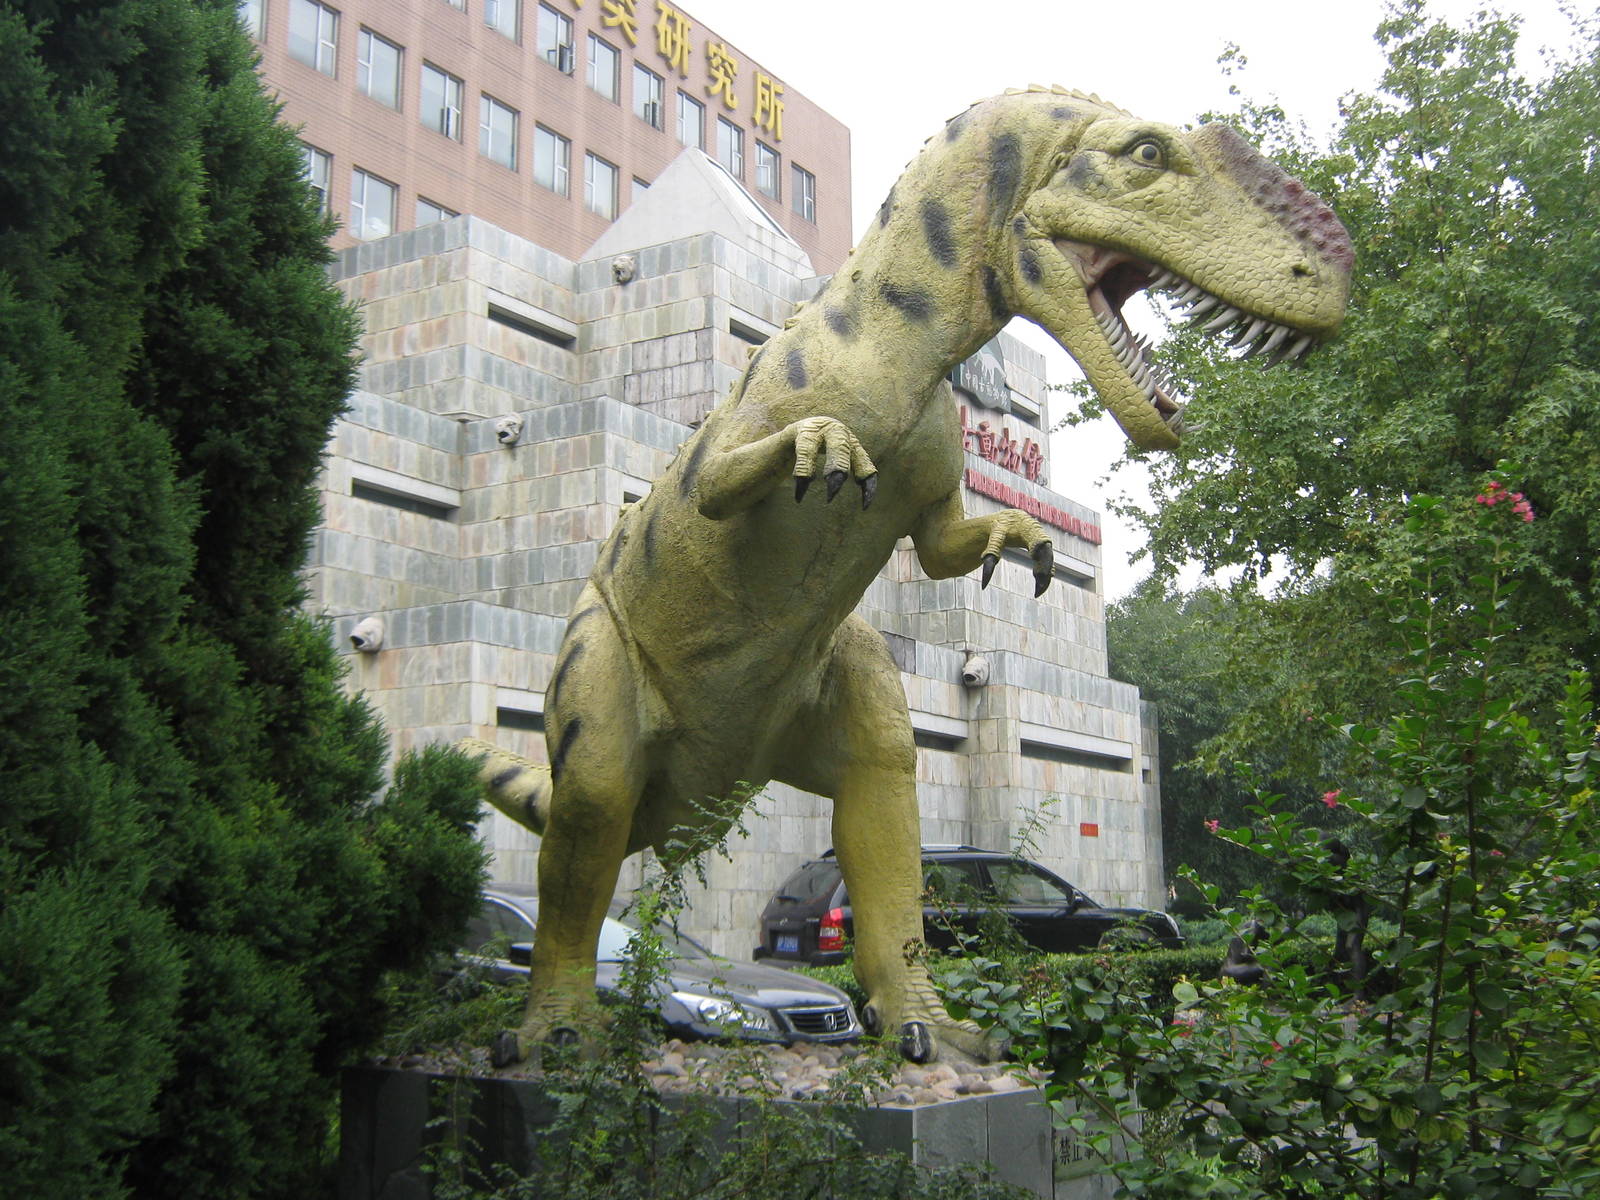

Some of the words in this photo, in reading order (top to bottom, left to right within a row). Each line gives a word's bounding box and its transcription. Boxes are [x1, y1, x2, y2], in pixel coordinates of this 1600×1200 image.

[574, 0, 785, 142] 类研究所
[1059, 1129, 1095, 1165] 禁止
